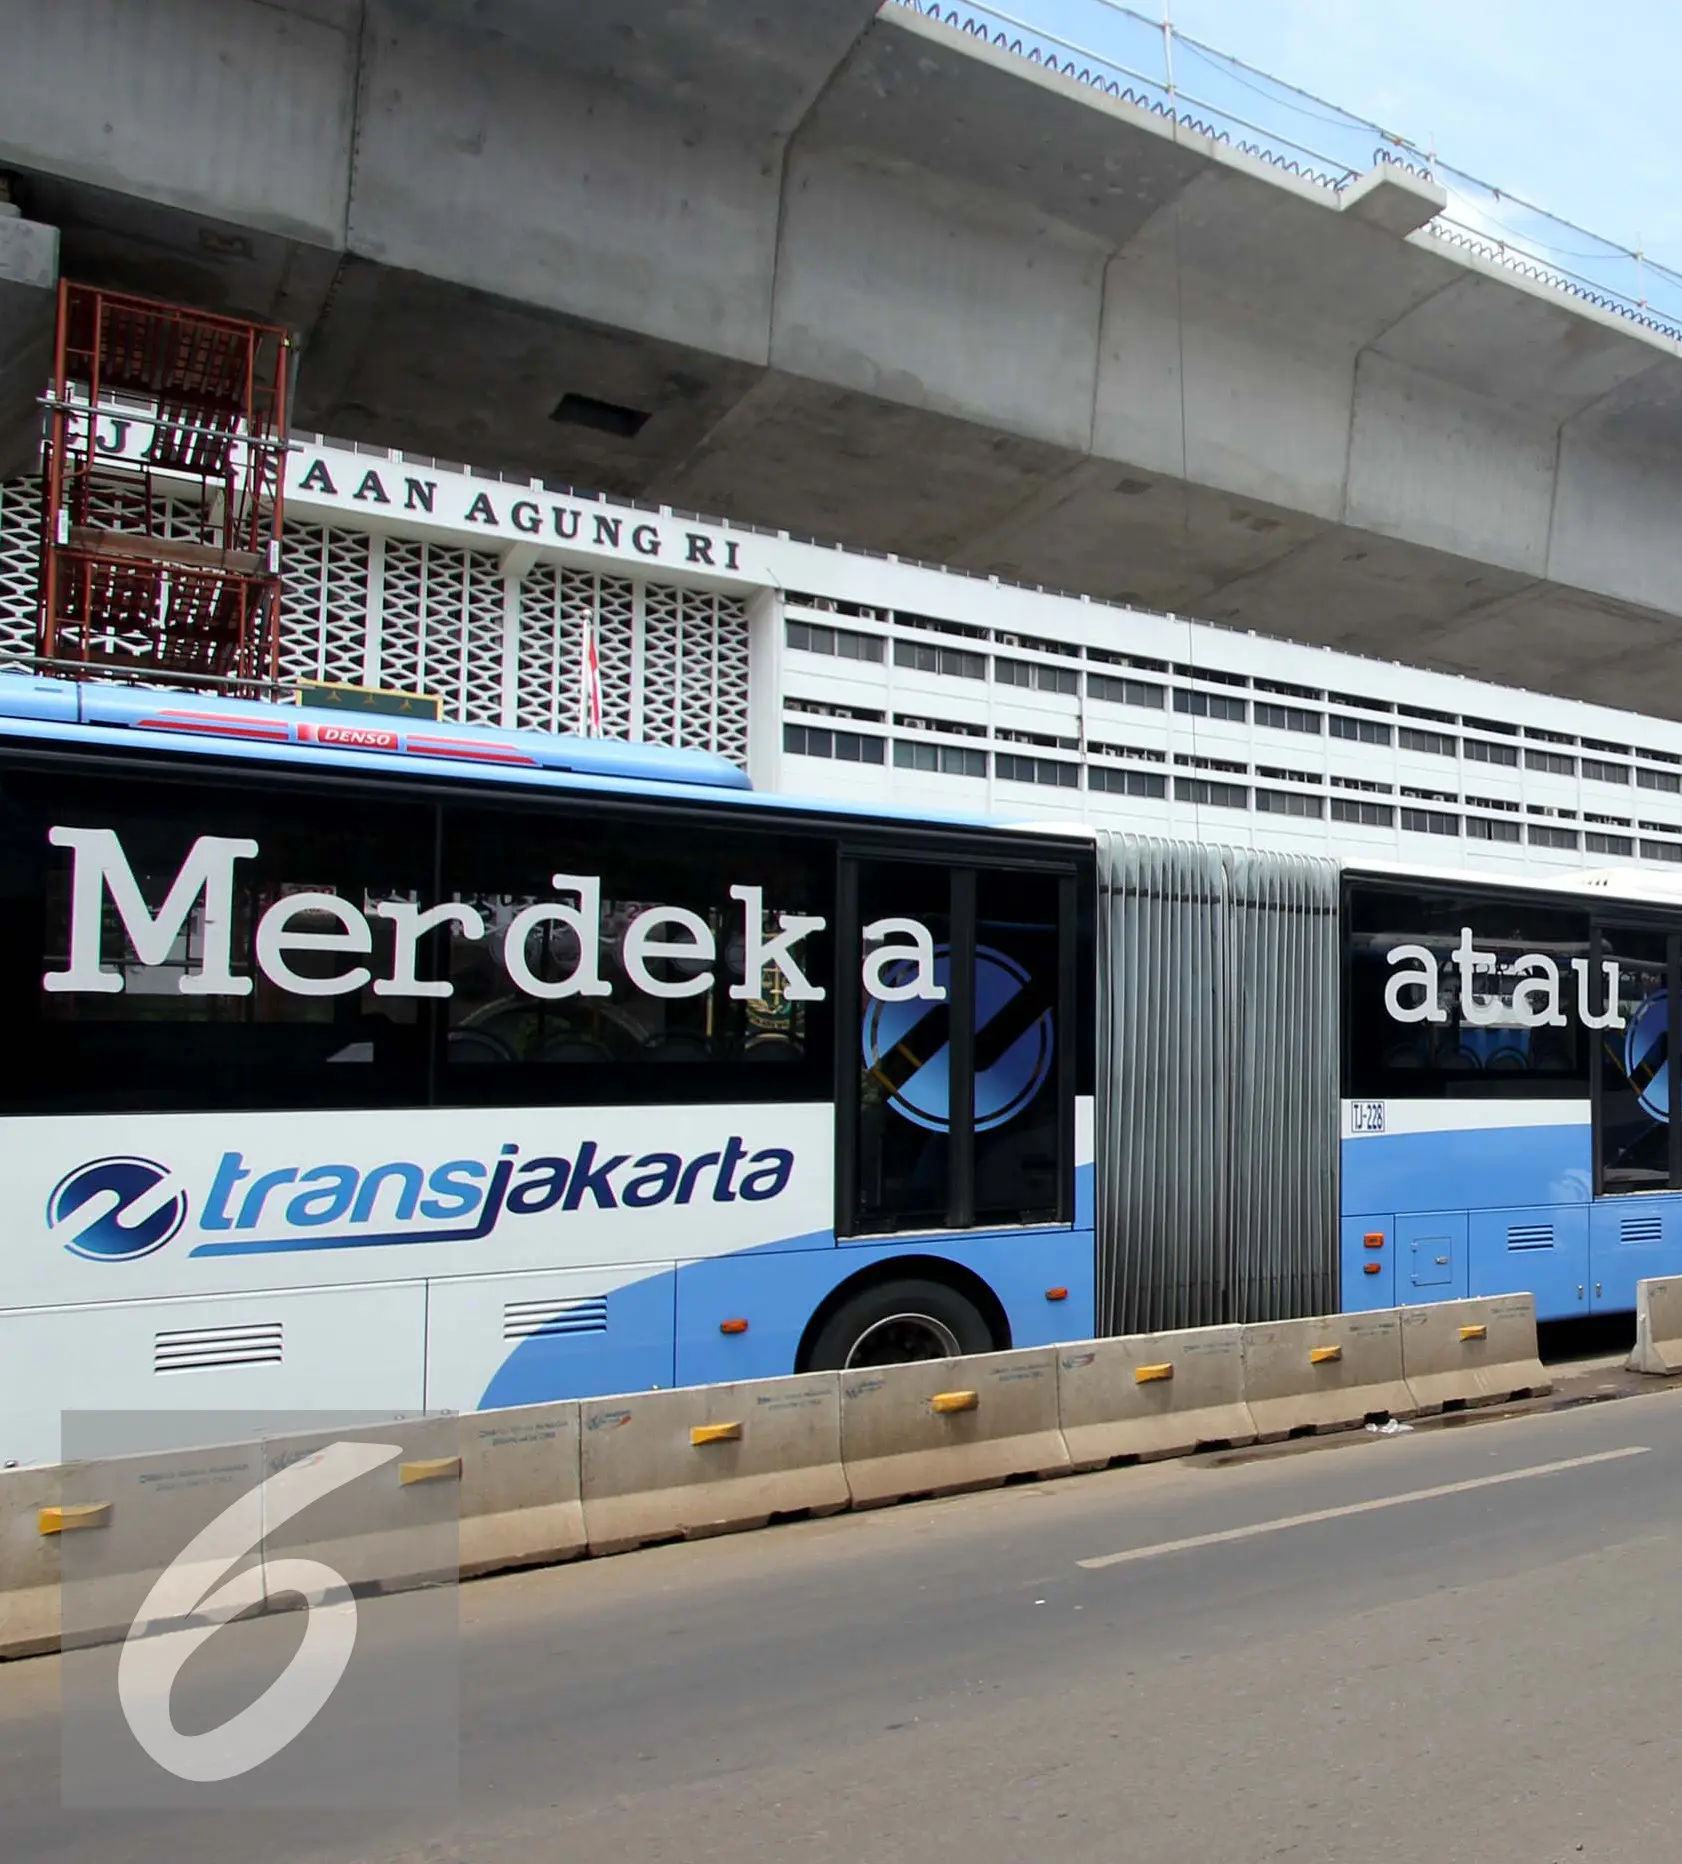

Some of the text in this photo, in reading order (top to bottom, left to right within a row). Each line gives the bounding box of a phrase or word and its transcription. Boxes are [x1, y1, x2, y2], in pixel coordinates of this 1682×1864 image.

[464, 491, 662, 556] AGUNG
[685, 532, 740, 571] RI
[324, 729, 391, 746] DENSO
[1384, 926, 1626, 1030] atau
[1353, 1103, 1383, 1130] TJ-228
[198, 1135, 795, 1242] transjakarta
